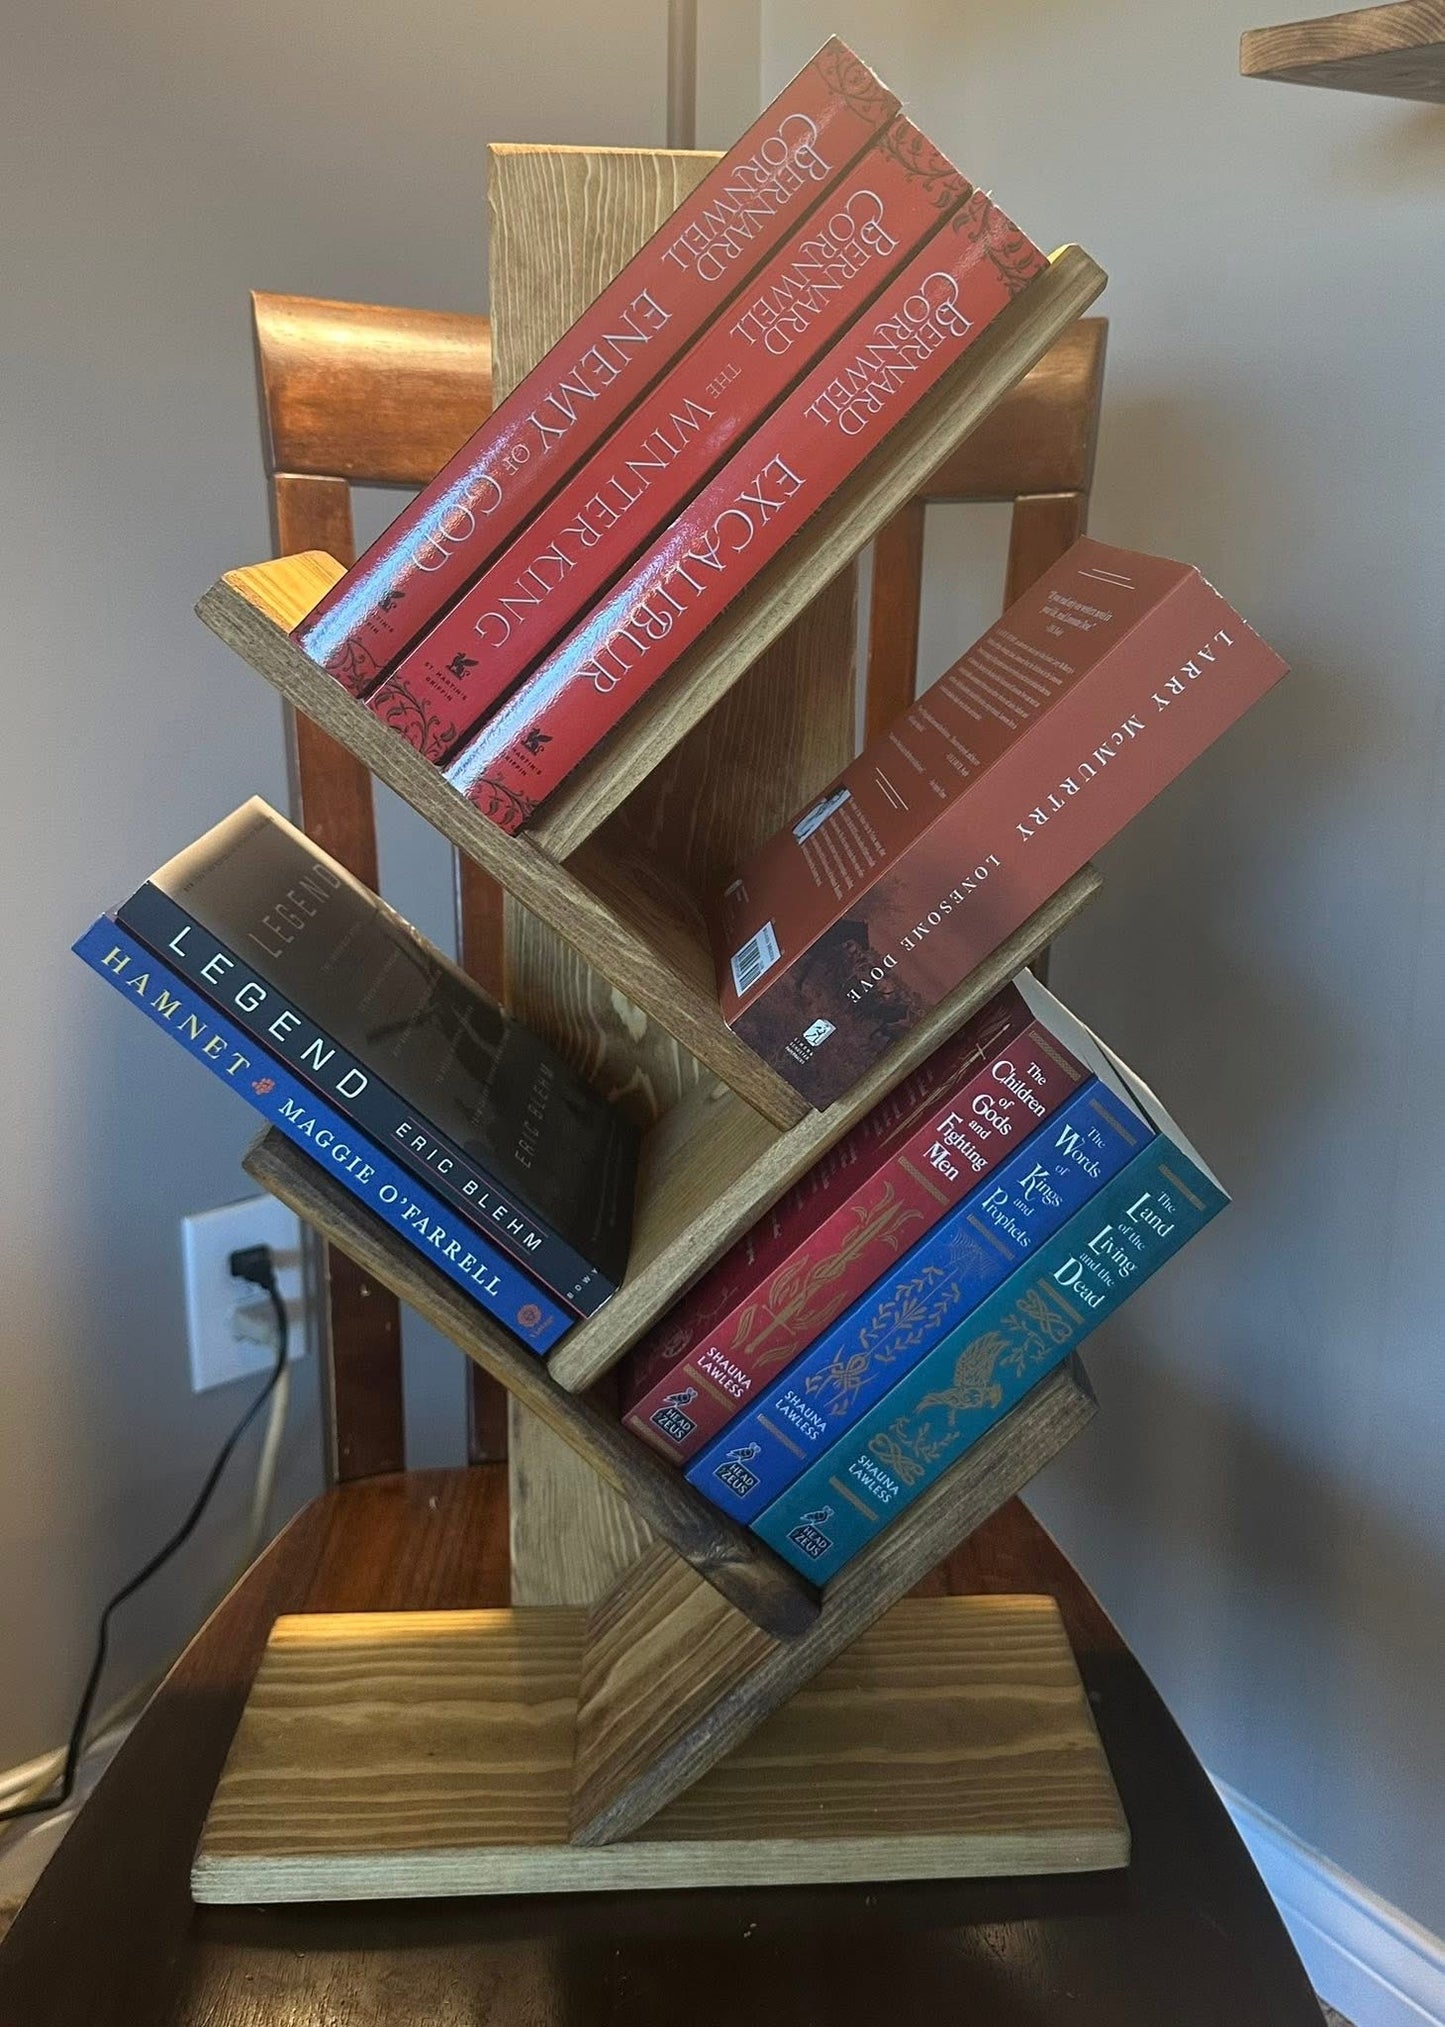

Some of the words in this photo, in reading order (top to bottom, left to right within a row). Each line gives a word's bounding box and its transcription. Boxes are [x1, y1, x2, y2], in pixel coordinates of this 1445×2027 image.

[661, 113, 817, 273] CORNWELL
[697, 145, 833, 281] BERNARD
[730, 190, 883, 345] CORNWELL
[764, 220, 900, 355] BERNARD
[525, 288, 672, 453] ENEMY
[803, 272, 959, 427] CORNWELL
[838, 301, 973, 435] BERNARD
[705, 362, 741, 399] THE
[502, 444, 530, 476] OF
[561, 399, 717, 547] WINTER
[412, 475, 502, 572] GOD
[474, 542, 578, 648] KING
[575, 453, 808, 692] EXCALIBUR
[1151, 630, 1234, 713] LARRY
[1016, 714, 1145, 842] McMURTRY
[248, 863, 342, 958] LEGEND
[900, 854, 1001, 952] LONESOME
[847, 954, 898, 1004] DOVE
[101, 947, 250, 1076] HAMNET
[169, 926, 368, 1099] LEGEND
[991, 1060, 1046, 1117] Children
[1026, 1062, 1047, 1086] The
[972, 1094, 1012, 1135] Gods
[999, 1097, 1015, 1110] of
[936, 1112, 988, 1171] Fighting
[968, 1119, 992, 1140] and
[1055, 1124, 1101, 1179] Words
[1087, 1126, 1106, 1149] The
[923, 1142, 959, 1181] Men
[1055, 1163, 1070, 1176] of
[278, 1099, 375, 1185] MAGGIE
[379, 1185, 502, 1296] O'FARRELL
[396, 1122, 453, 1173] ERIC
[463, 1180, 541, 1251] BLEHM
[1013, 1198, 1034, 1216] and
[1017, 1163, 1063, 1207] Kings
[1158, 1191, 1176, 1214] The
[982, 1187, 1031, 1248] Prophets
[1118, 1223, 1131, 1235] of
[1127, 1229, 1145, 1251] the
[1126, 1192, 1174, 1237] Land
[1079, 1252, 1101, 1270] and
[1098, 1267, 1115, 1287] the
[1088, 1224, 1137, 1278] Living
[1053, 1257, 1106, 1308] Dead
[697, 1356, 744, 1398] LAWLESS
[707, 1347, 752, 1389] SHAUNA
[659, 1413, 686, 1440] ZEUS
[665, 1407, 691, 1432] HEAD
[776, 1400, 820, 1440] LAWLESS
[785, 1391, 827, 1432] SHAUNA
[721, 1469, 747, 1495] ZEUS
[729, 1462, 754, 1487] HEAD
[849, 1464, 891, 1504] LAWLESS
[858, 1455, 900, 1496] SHAUNA
[795, 1533, 820, 1558] ZEUS
[802, 1527, 827, 1550] HEAD
